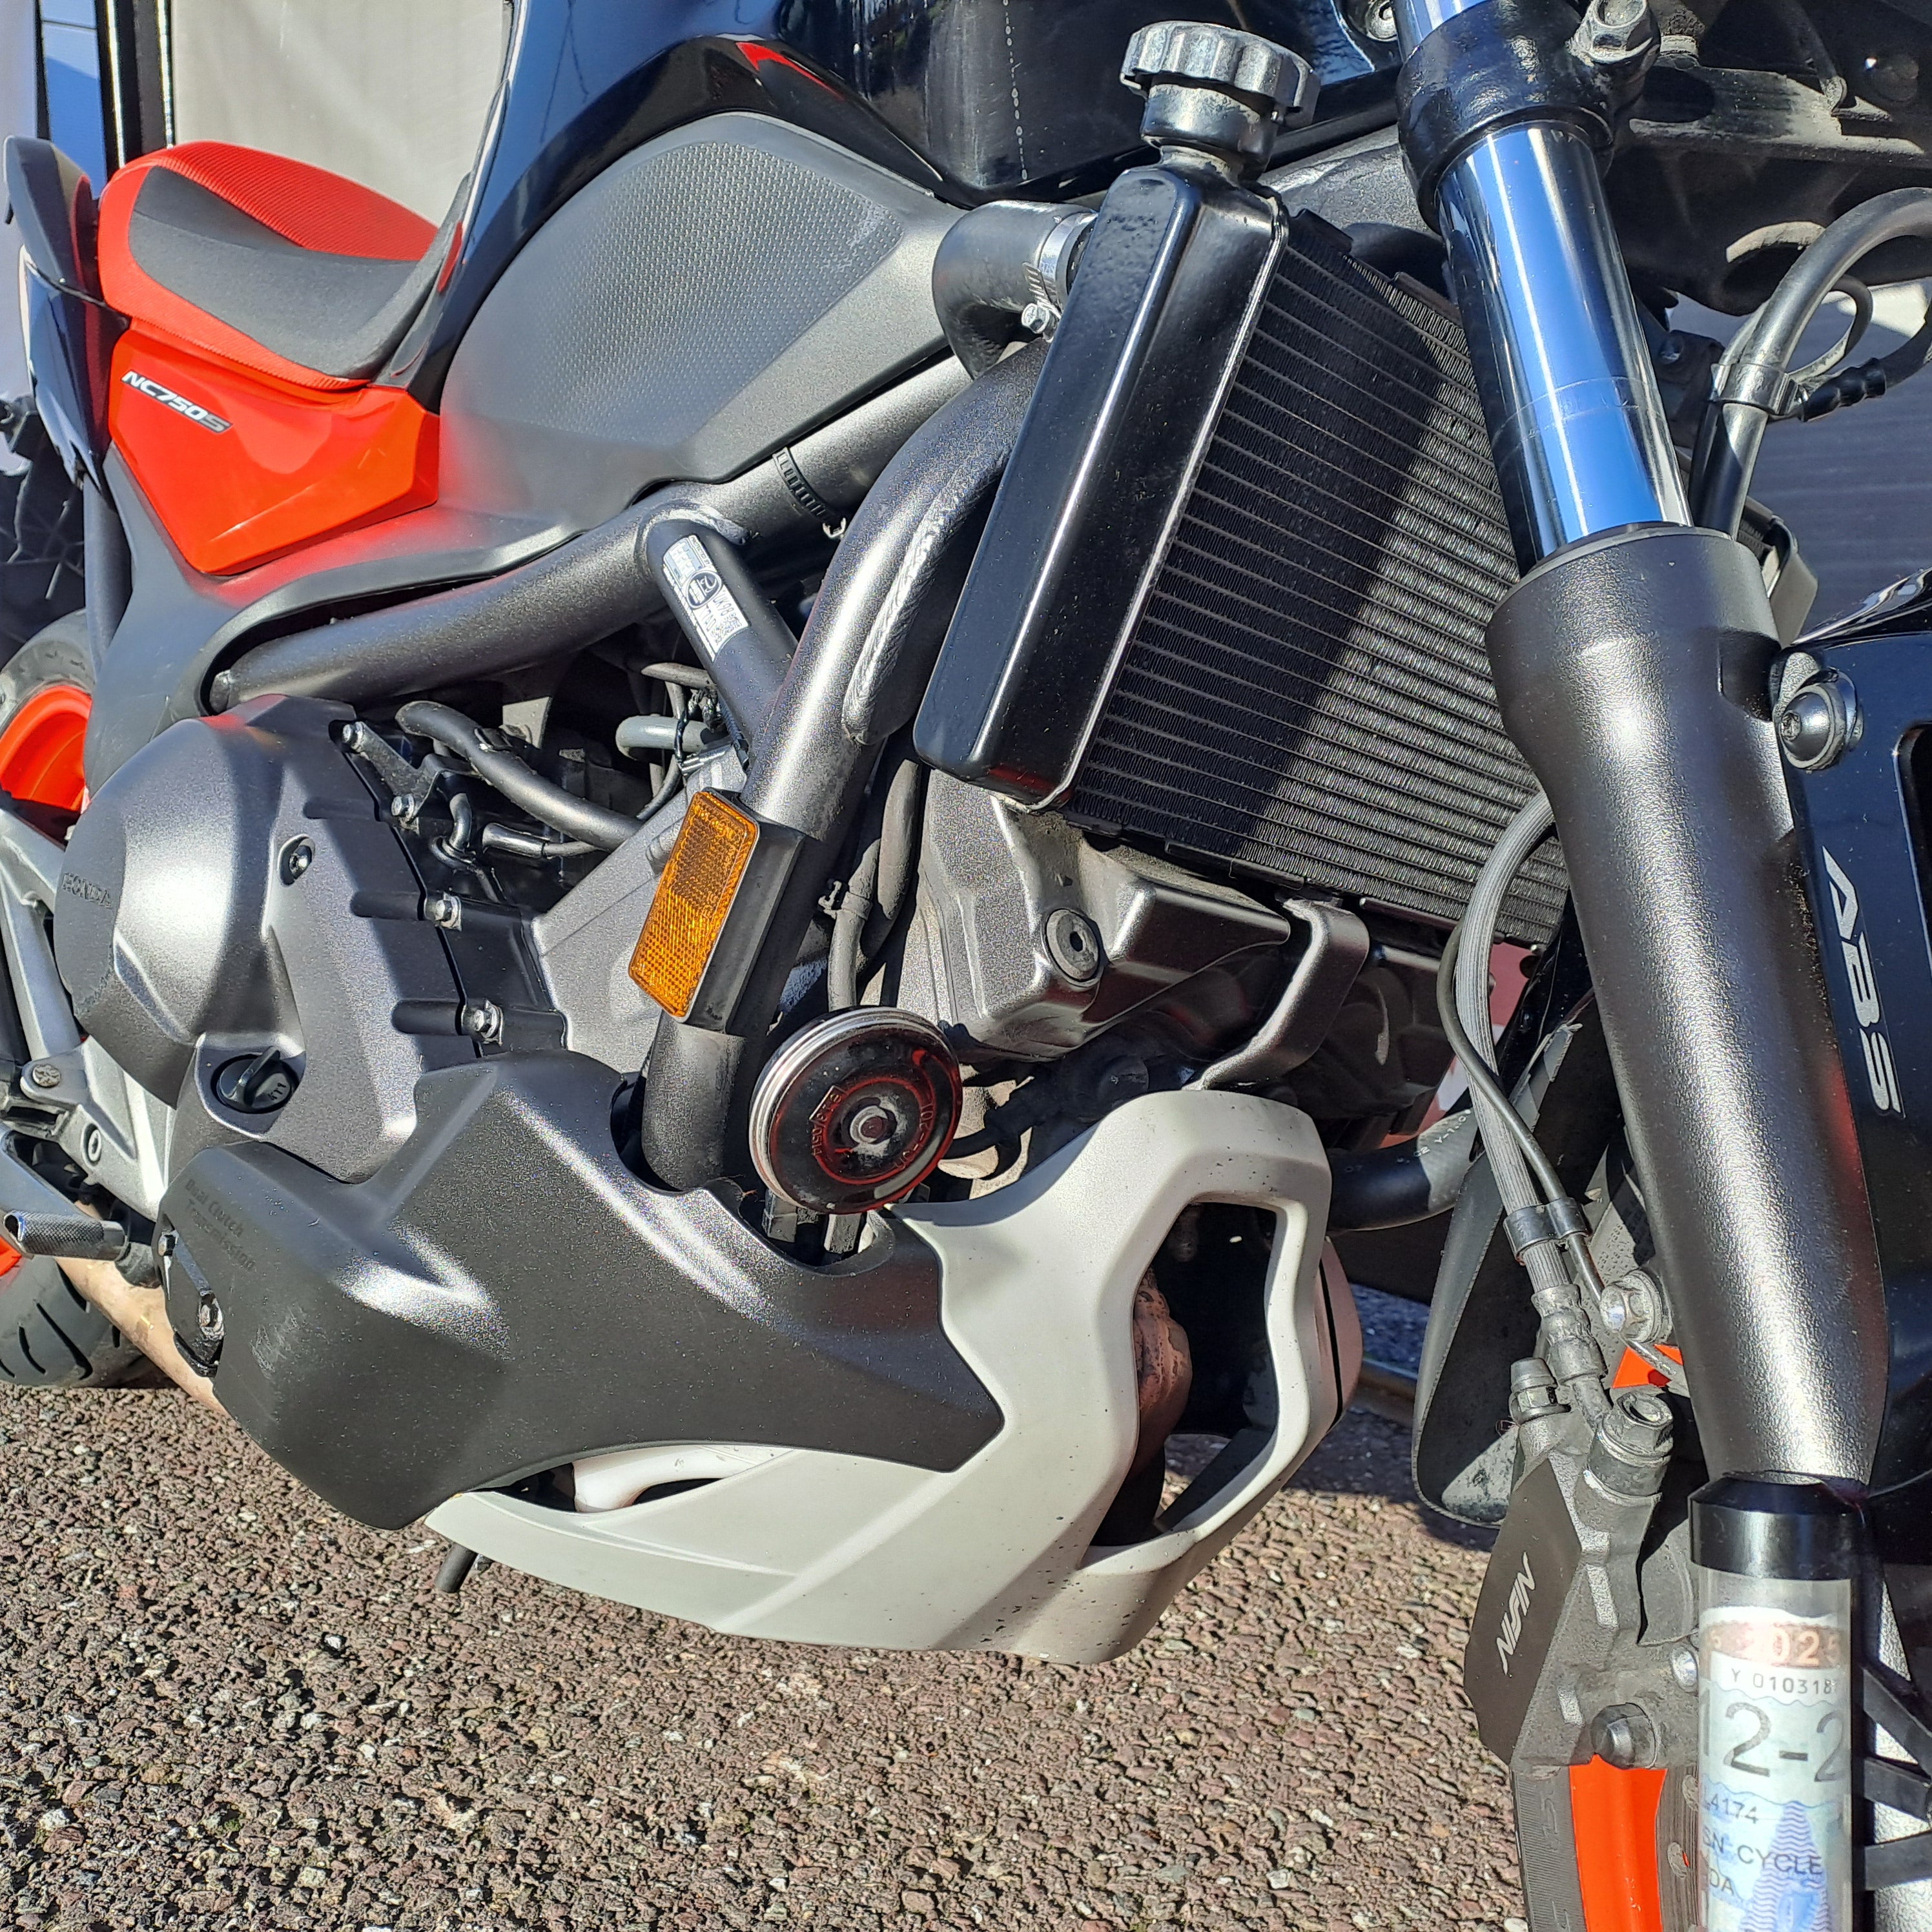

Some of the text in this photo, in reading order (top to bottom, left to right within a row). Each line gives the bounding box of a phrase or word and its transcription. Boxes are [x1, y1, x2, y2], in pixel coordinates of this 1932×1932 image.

[121, 371, 231, 432] NC750S
[712, 593, 733, 617] UK98
[63, 873, 111, 909] HONDA
[1822, 845, 1903, 1114] ABS
[185, 1179, 244, 1238] Dual Clutch
[1731, 1668, 1741, 1682] Y
[1704, 1794, 1758, 1824] 4174
[1737, 1844, 1823, 1875] CYCLE
